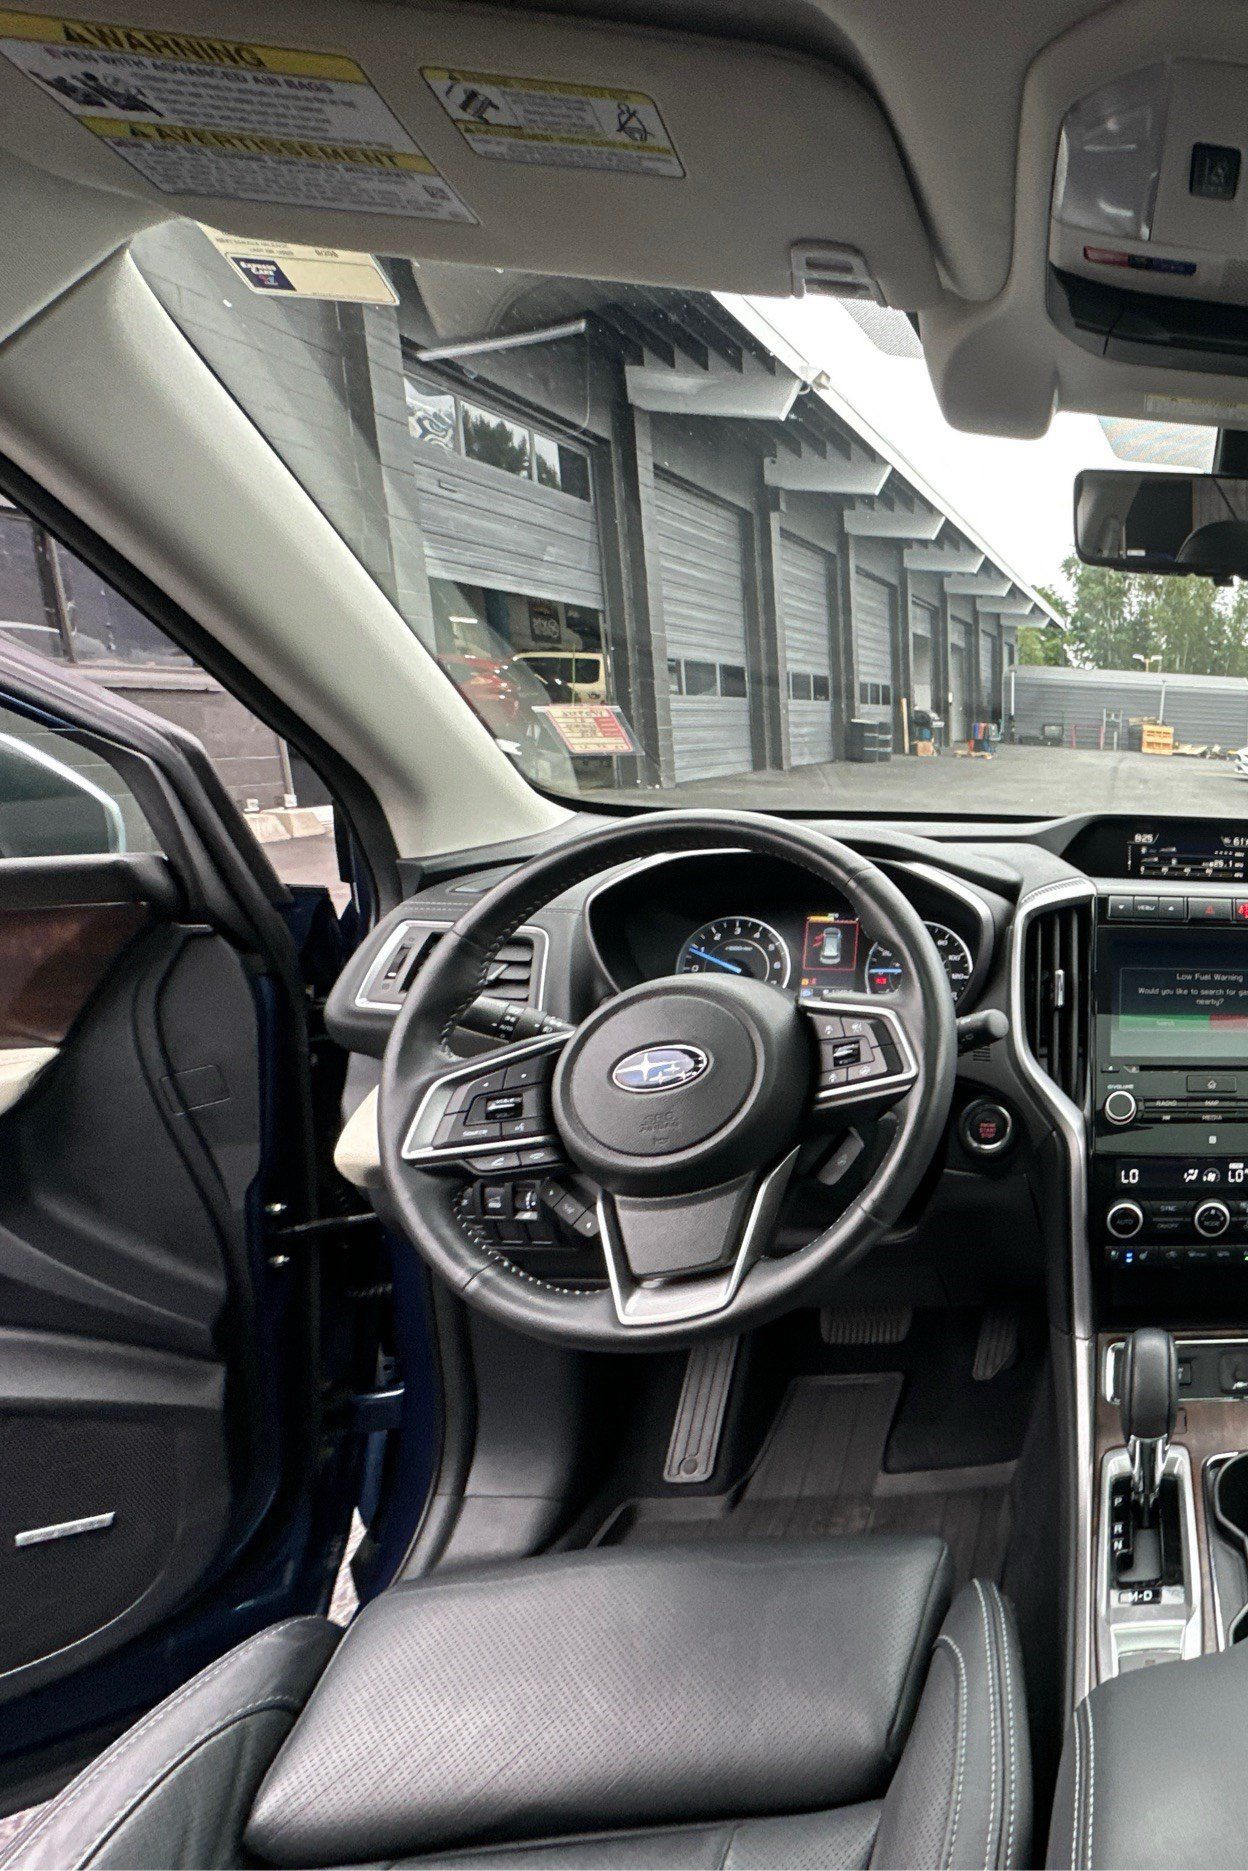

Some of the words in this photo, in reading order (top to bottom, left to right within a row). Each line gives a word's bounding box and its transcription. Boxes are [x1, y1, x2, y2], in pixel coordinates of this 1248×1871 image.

[81, 24, 267, 68] WARNING
[1213, 973, 1244, 983] Warning
[1175, 987, 1188, 995] like
[1196, 998, 1225, 1007] nearby?
[1121, 1169, 1139, 1184] LO
[1228, 1169, 1244, 1183] LO
[1114, 1496, 1123, 1507] P
[1114, 1524, 1123, 1534] R
[1113, 1540, 1123, 1550] N
